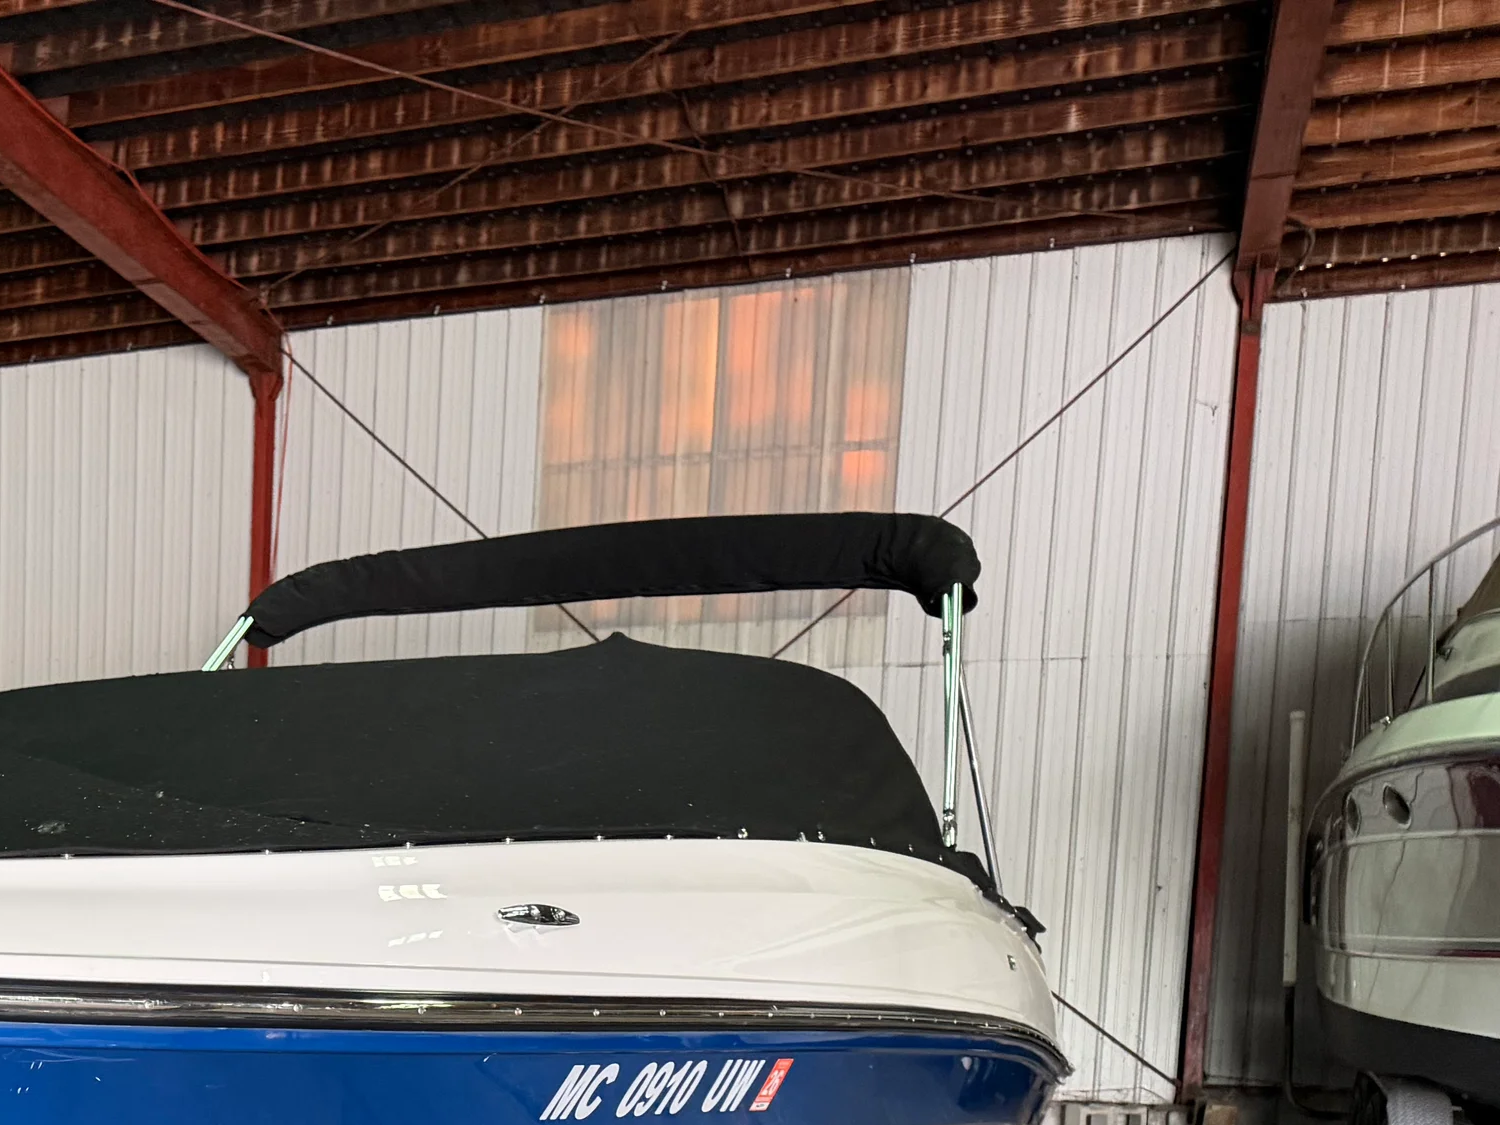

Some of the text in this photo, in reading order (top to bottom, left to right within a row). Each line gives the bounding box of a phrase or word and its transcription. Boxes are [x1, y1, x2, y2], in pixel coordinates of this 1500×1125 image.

[539, 1059, 766, 1121] MC 0910 UW
[761, 1069, 785, 1096] 26
